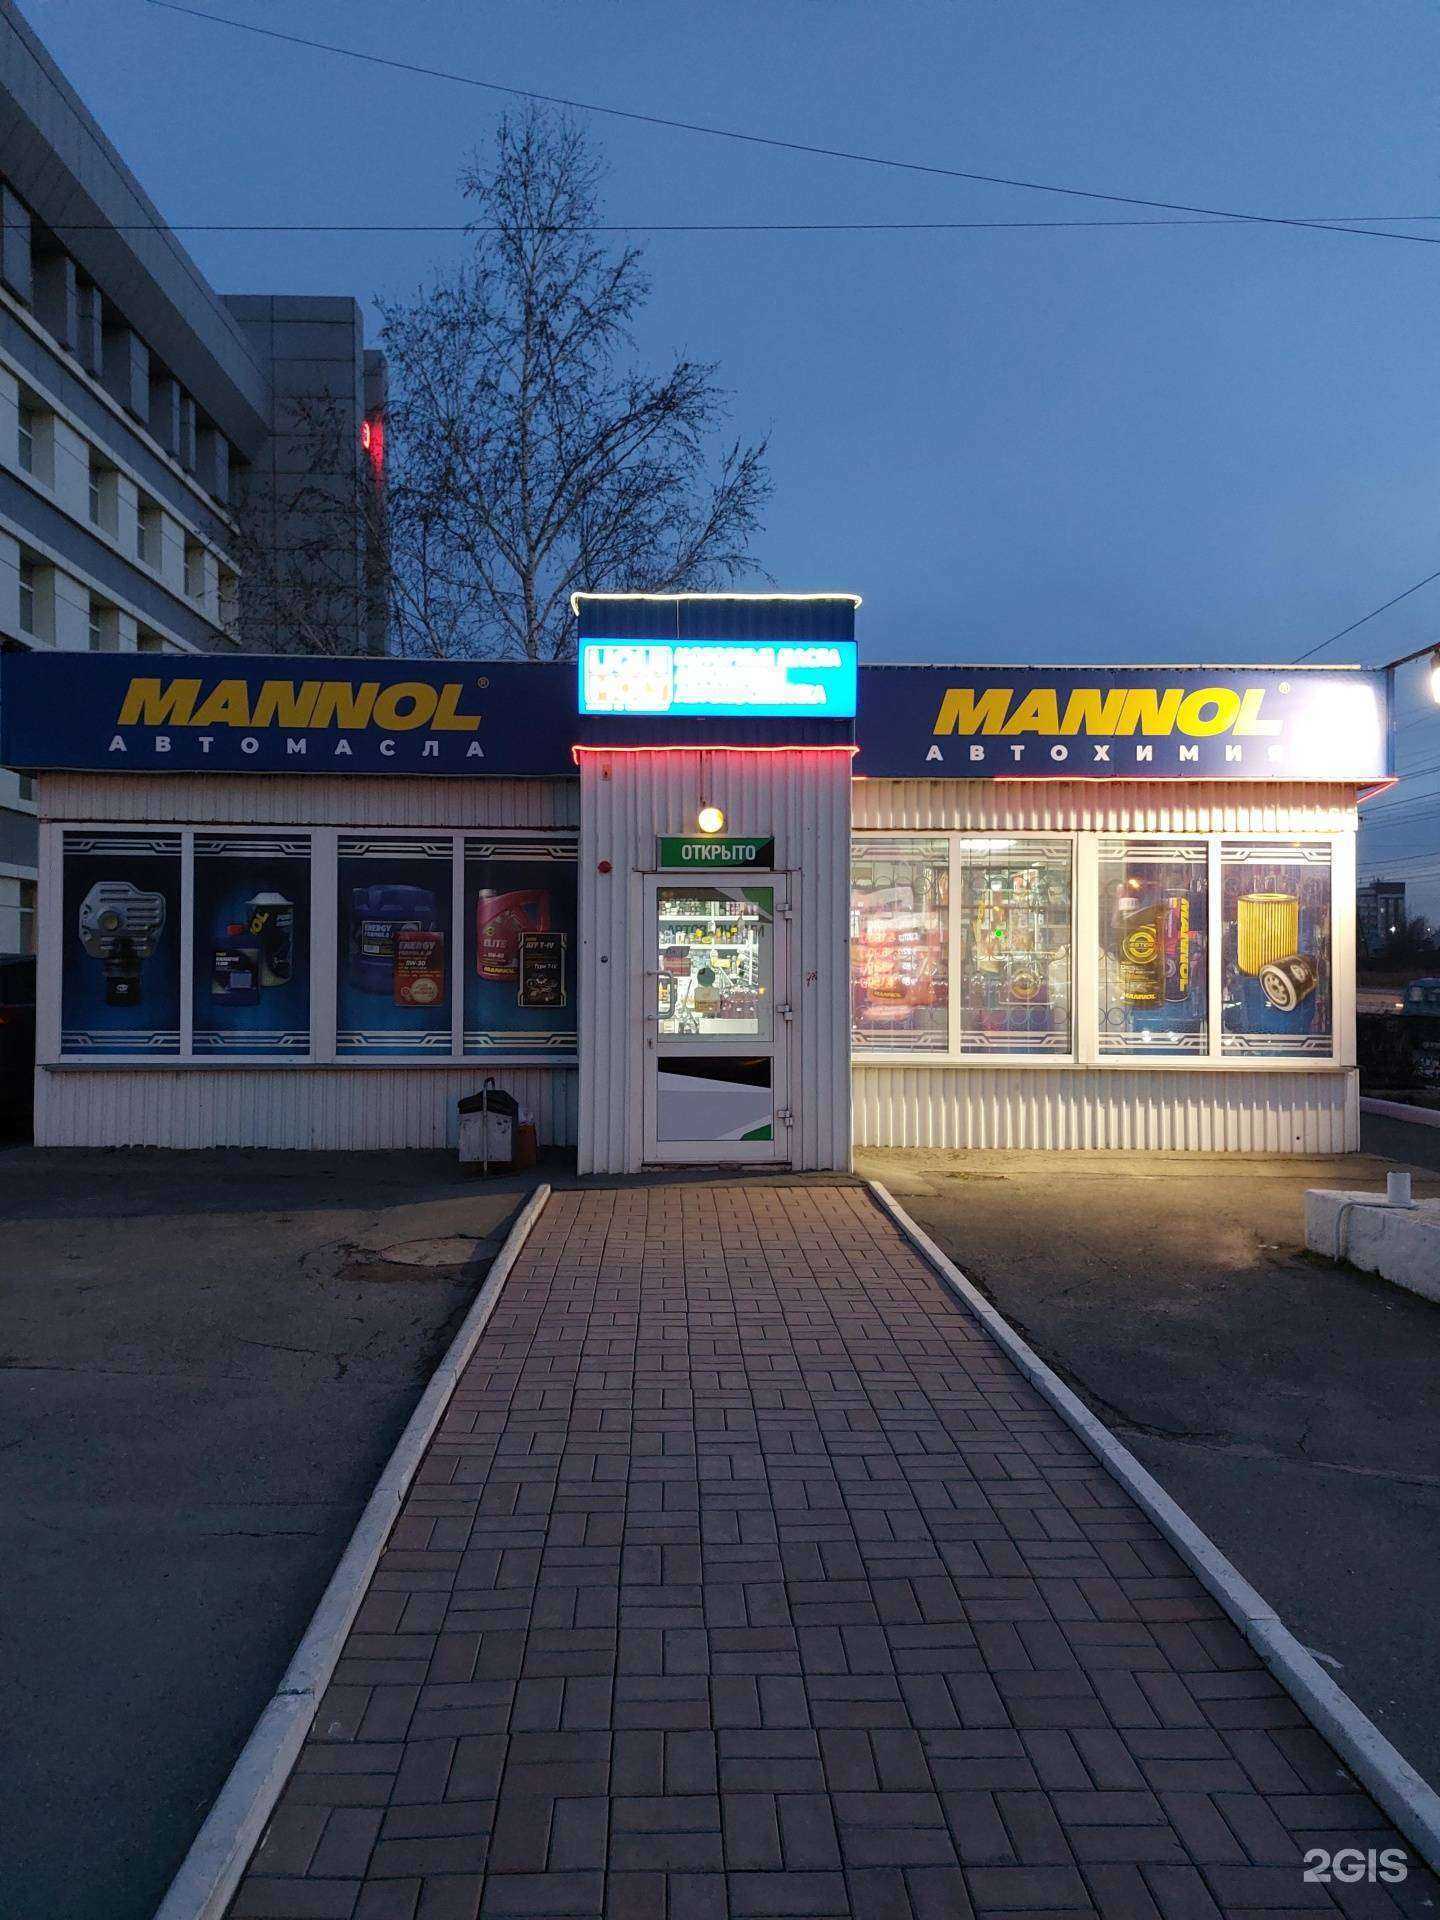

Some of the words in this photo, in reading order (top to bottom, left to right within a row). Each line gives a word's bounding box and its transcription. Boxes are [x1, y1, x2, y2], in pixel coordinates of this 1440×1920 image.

[117, 678, 481, 731] MANNOL
[933, 688, 1283, 736] MANNOL
[108, 735, 485, 758] АВТОМАСЛА
[681, 844, 756, 861] ОТКРЫТО
